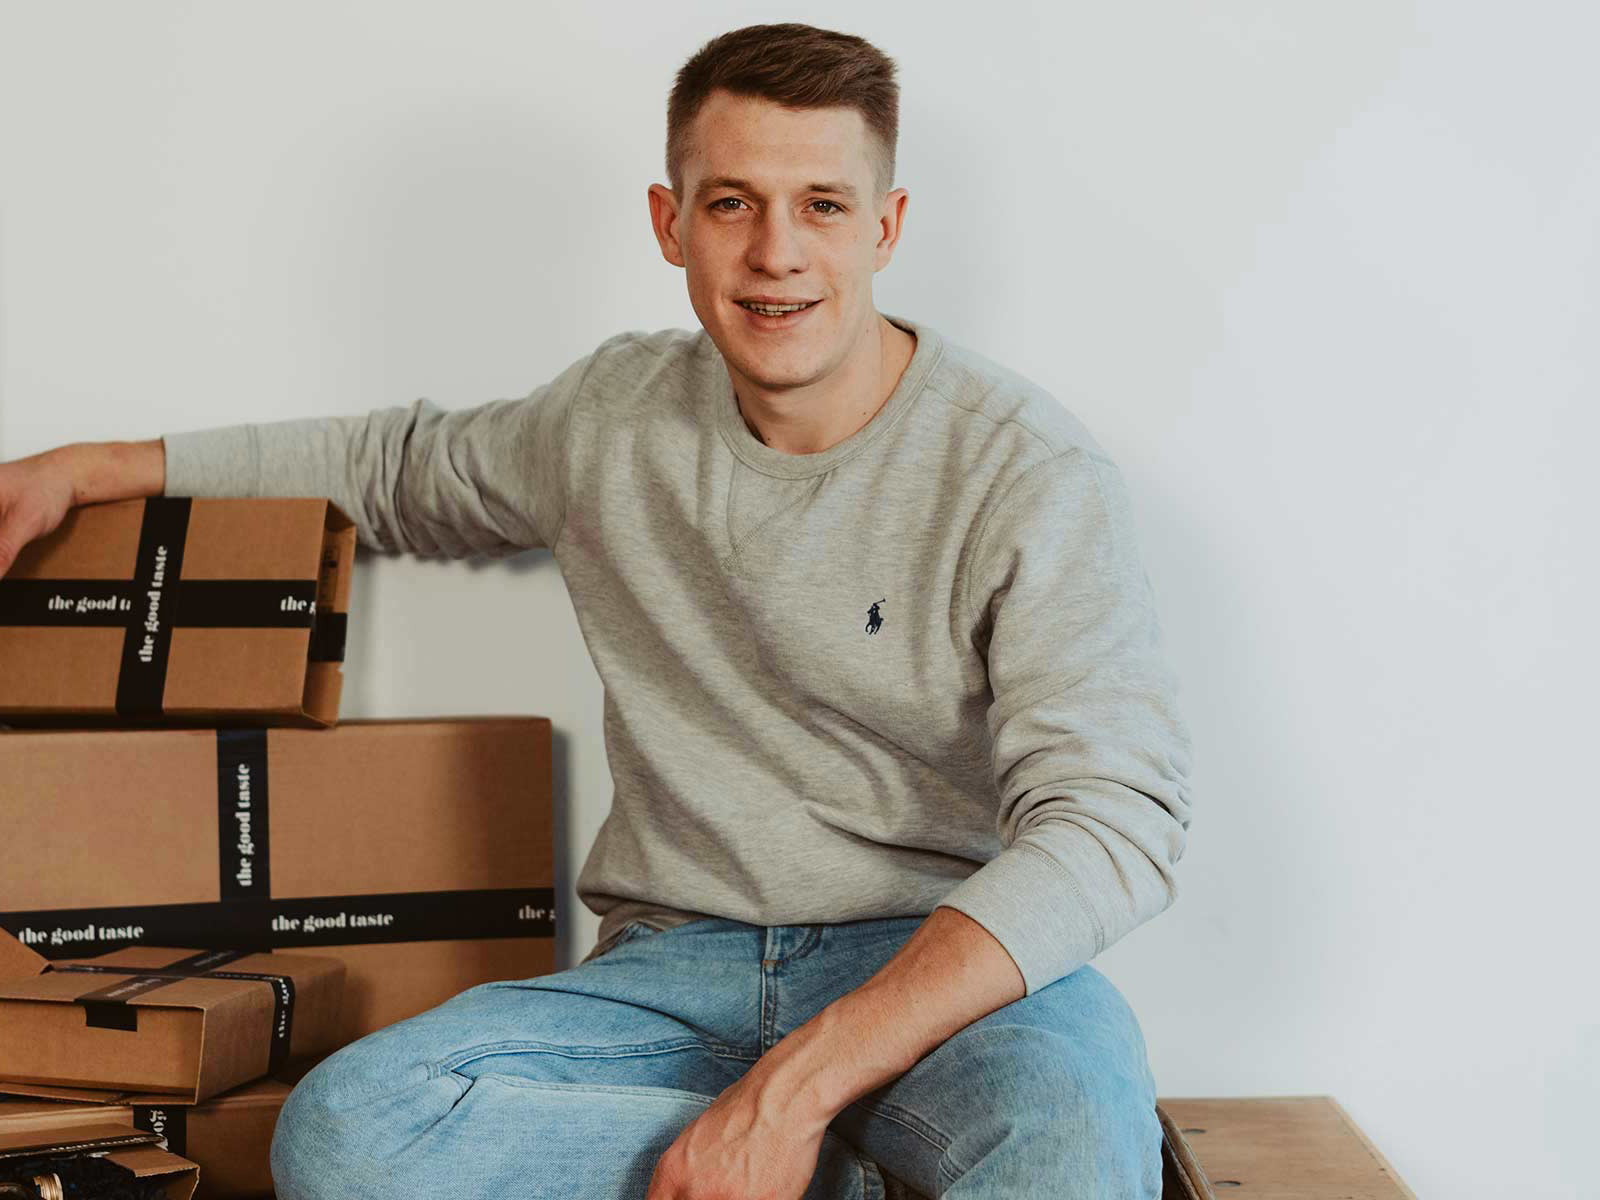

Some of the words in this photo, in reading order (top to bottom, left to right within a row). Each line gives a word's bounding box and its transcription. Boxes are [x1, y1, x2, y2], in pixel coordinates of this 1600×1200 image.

[152, 545, 168, 588] taste
[48, 595, 74, 610] the
[76, 596, 117, 613] good
[144, 591, 161, 632] good
[280, 595, 308, 611] the
[138, 635, 155, 662] the
[237, 763, 251, 808] taste
[235, 811, 255, 855] good
[236, 858, 252, 886] the
[271, 915, 300, 931] the
[303, 912, 346, 933] good
[350, 913, 394, 928] taste
[518, 904, 546, 920] the
[18, 927, 48, 944] the
[51, 924, 96, 945] good
[99, 925, 144, 941] taste
